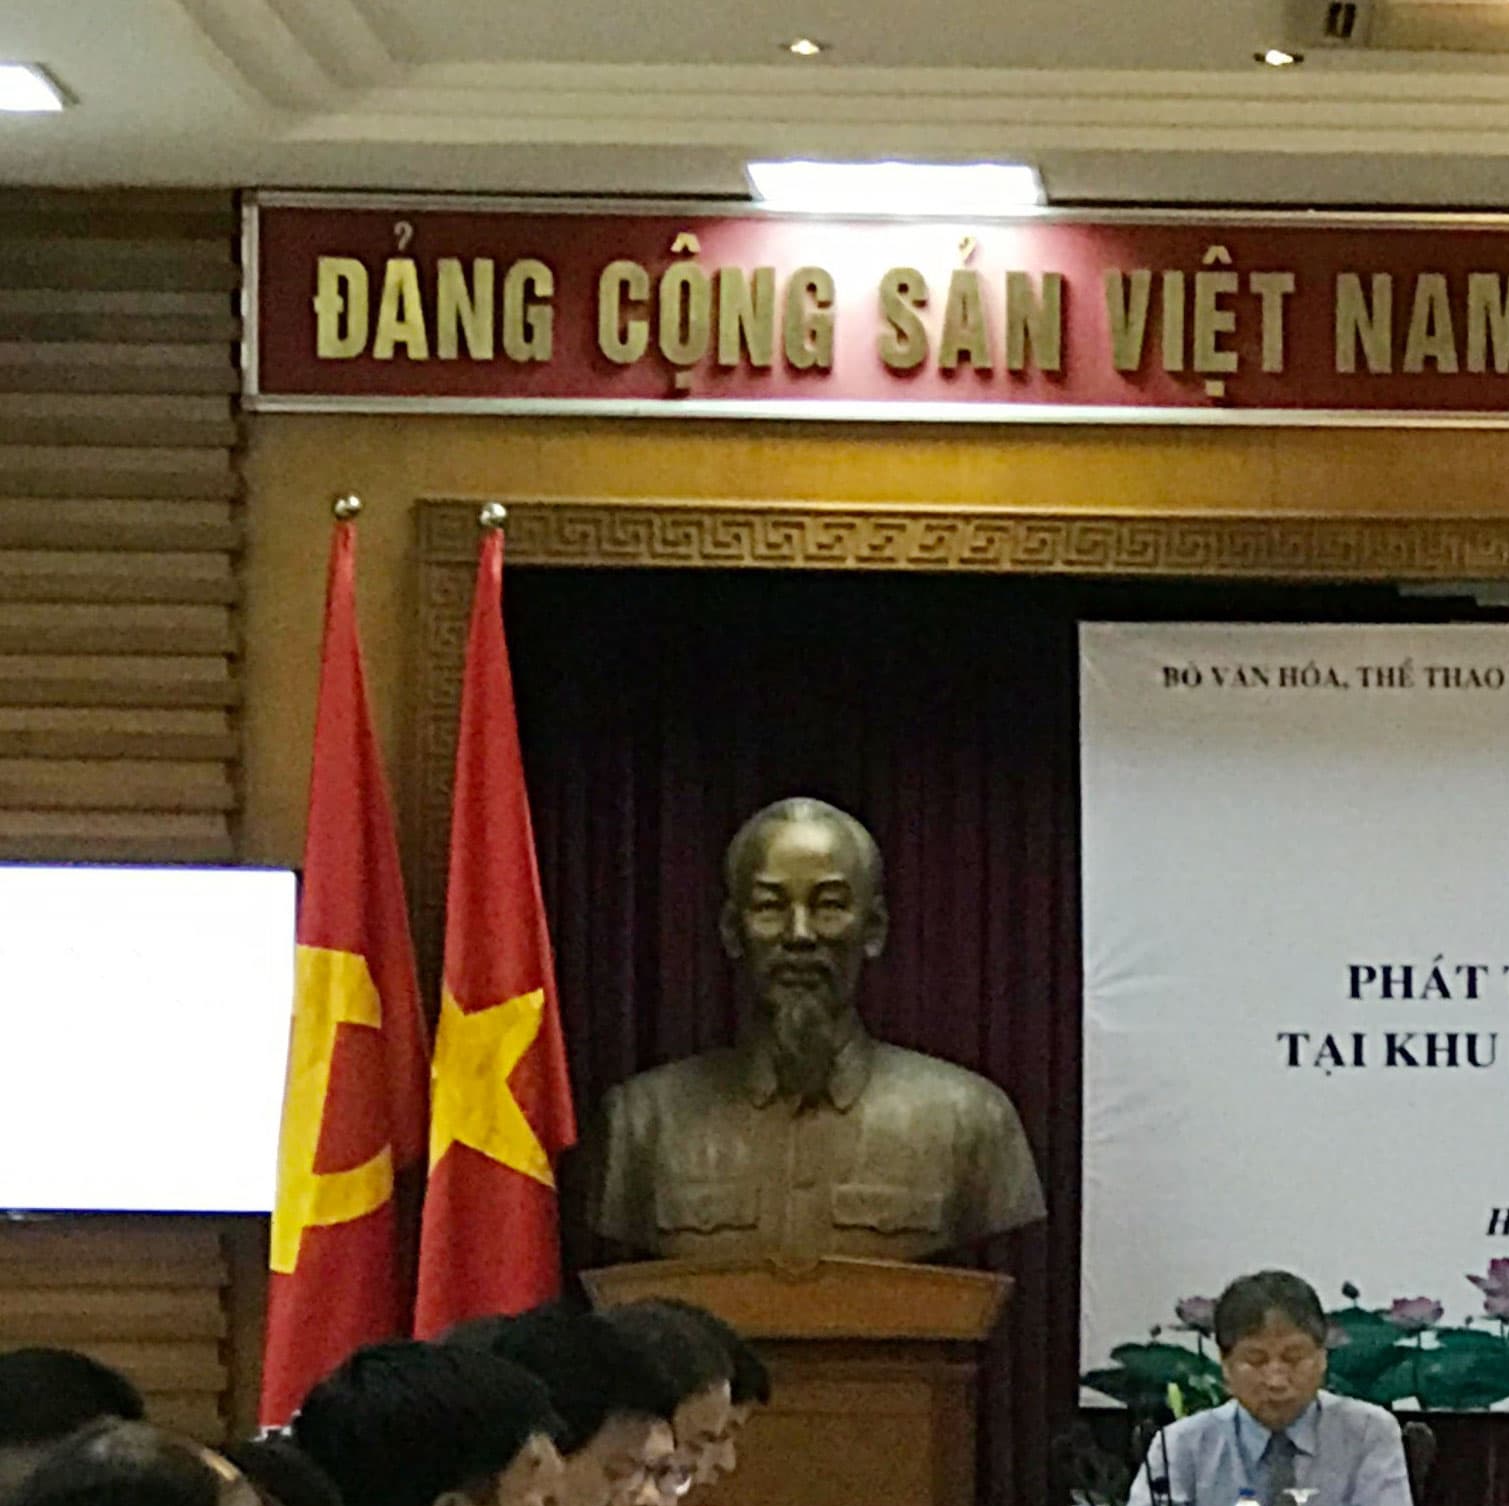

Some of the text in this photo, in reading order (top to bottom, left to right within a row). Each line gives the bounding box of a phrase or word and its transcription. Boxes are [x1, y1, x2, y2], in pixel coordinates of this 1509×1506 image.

[313, 221, 554, 361] ĐẢNG
[598, 232, 838, 394] CỘNG
[877, 236, 1063, 372] SẢN
[1104, 245, 1295, 395] VIỆT
[1424, 666, 1506, 689] THAO
[1347, 953, 1490, 1000] PHÁT
[1276, 1032, 1368, 1077] TẠI
[1383, 1033, 1499, 1068] KHU
